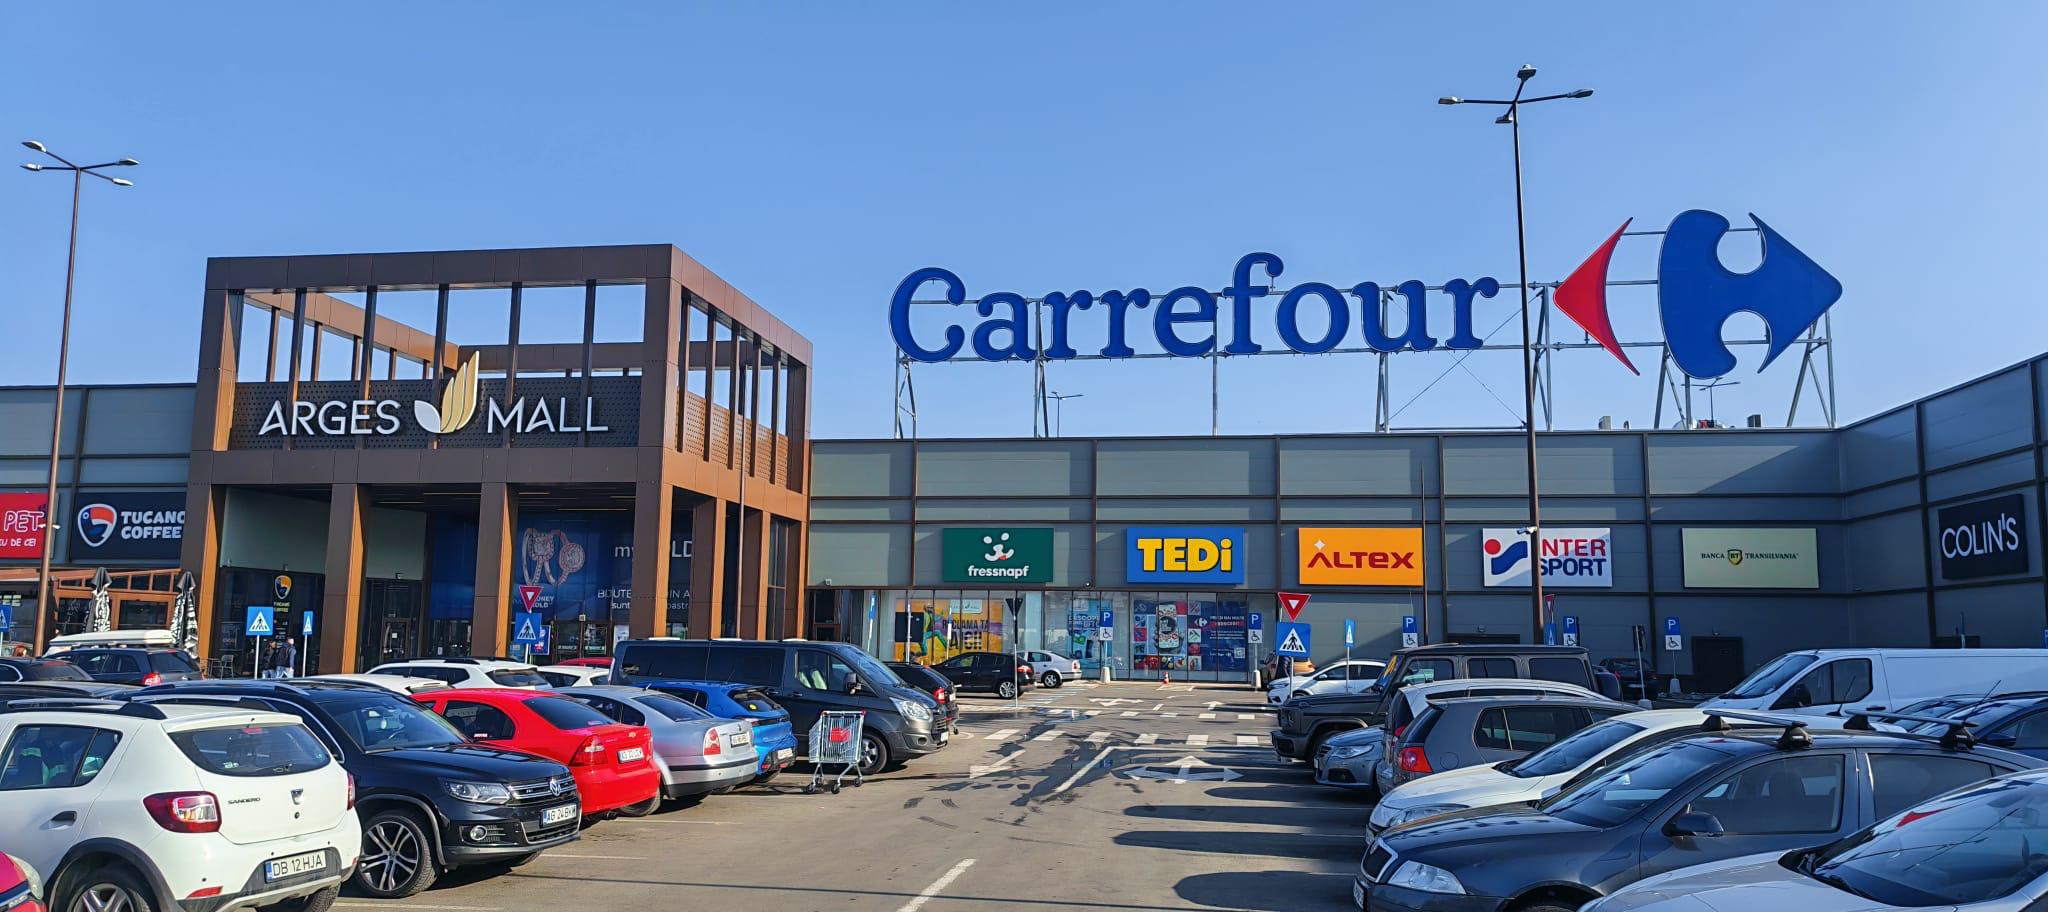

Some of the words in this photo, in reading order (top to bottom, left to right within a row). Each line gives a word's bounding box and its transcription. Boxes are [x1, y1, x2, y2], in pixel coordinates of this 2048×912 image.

[889, 252, 1500, 362] Carrefour
[258, 399, 401, 435] ARGES
[487, 396, 609, 433] MALL
[4, 509, 45, 533] PET
[121, 526, 182, 539] COFFEE
[1942, 513, 2018, 558] COLIN'S
[10, 538, 22, 547] DE
[1541, 538, 1606, 557] NTER
[1137, 538, 1232, 572] TEDi
[1745, 552, 1797, 560] TRANSILVANIA
[967, 564, 1030, 579] fressnapf
[1103, 612, 1111, 622] P
[1251, 614, 1259, 625] P
[1405, 617, 1414, 628] P
[1566, 618, 1574, 628] P
[1667, 619, 1676, 630] P
[227, 797, 261, 805] SANDERO
[272, 861, 289, 877] DB
[291, 859, 302, 873] 12
[302, 854, 323, 870] HJA
